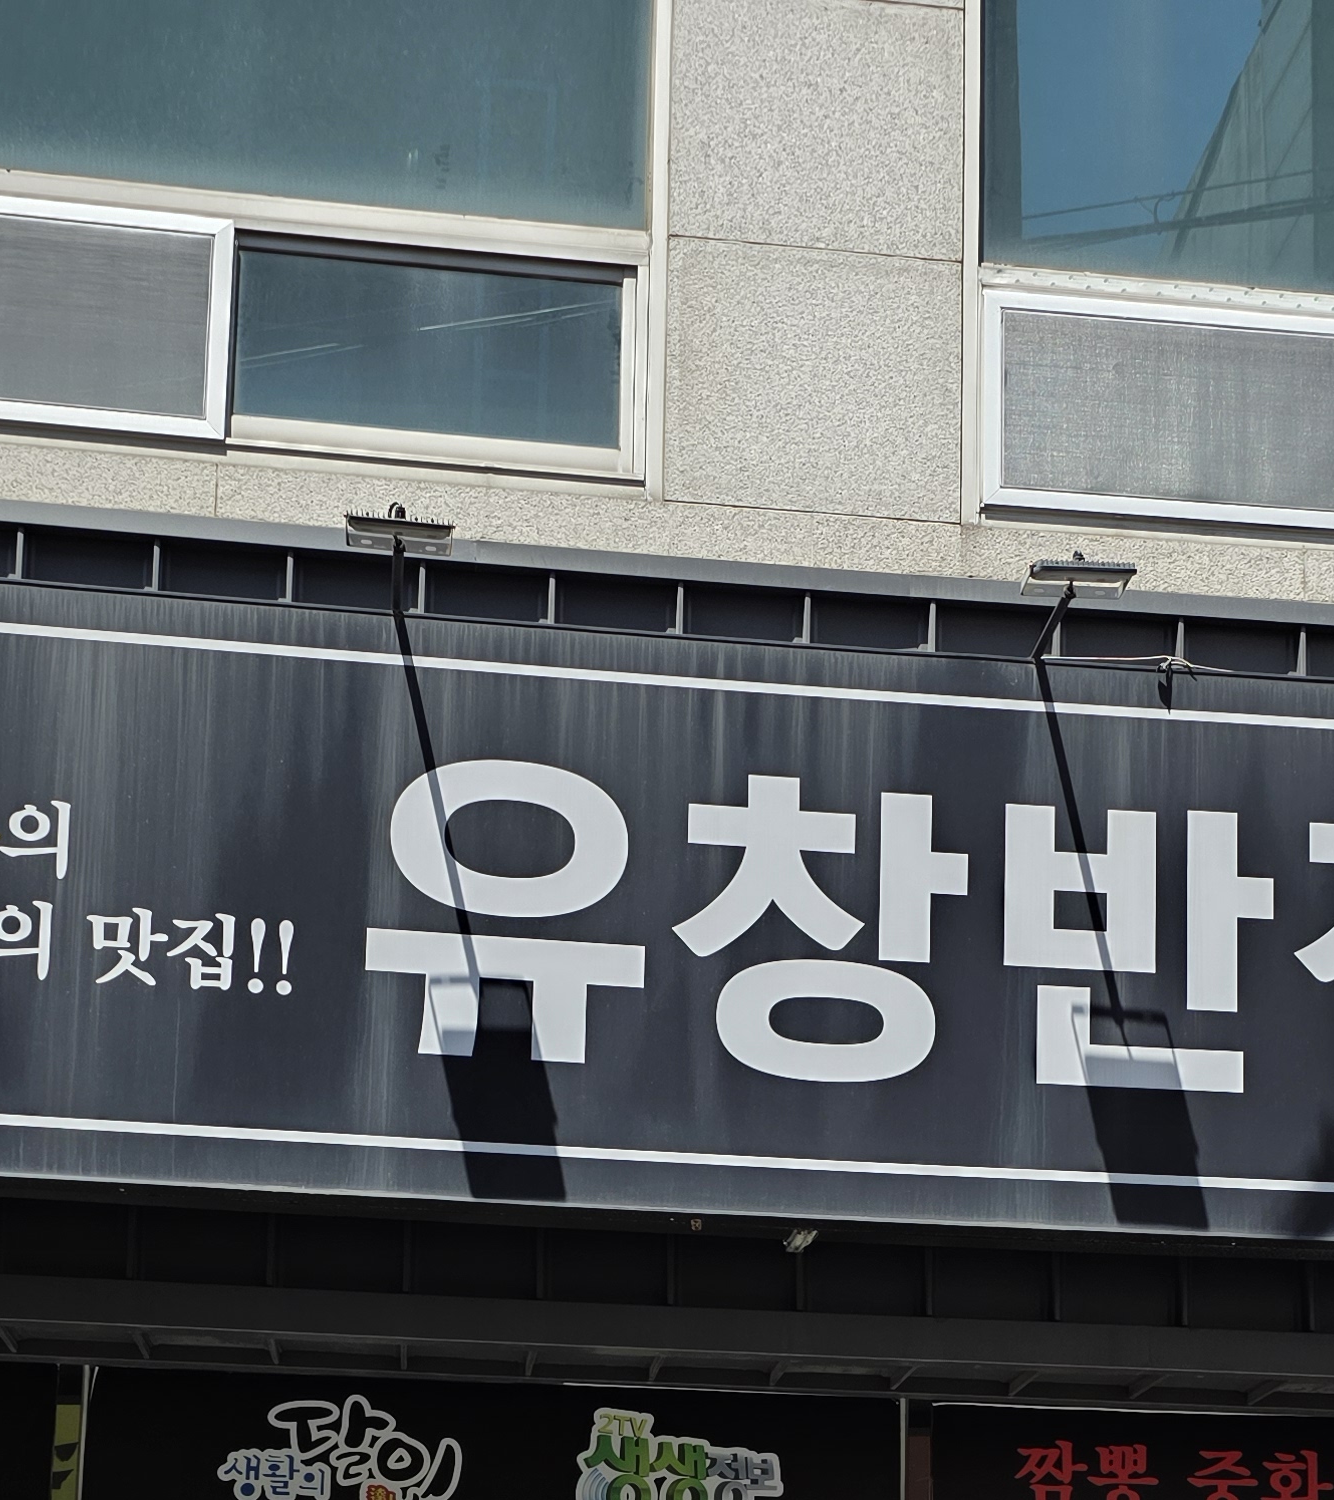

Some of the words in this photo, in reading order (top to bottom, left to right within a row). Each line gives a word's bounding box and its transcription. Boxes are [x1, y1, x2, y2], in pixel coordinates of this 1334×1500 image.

[87, 907, 295, 995] 맛집!!
[598, 1411, 651, 1437] 2TV
[223, 1451, 331, 1500] 생활의
